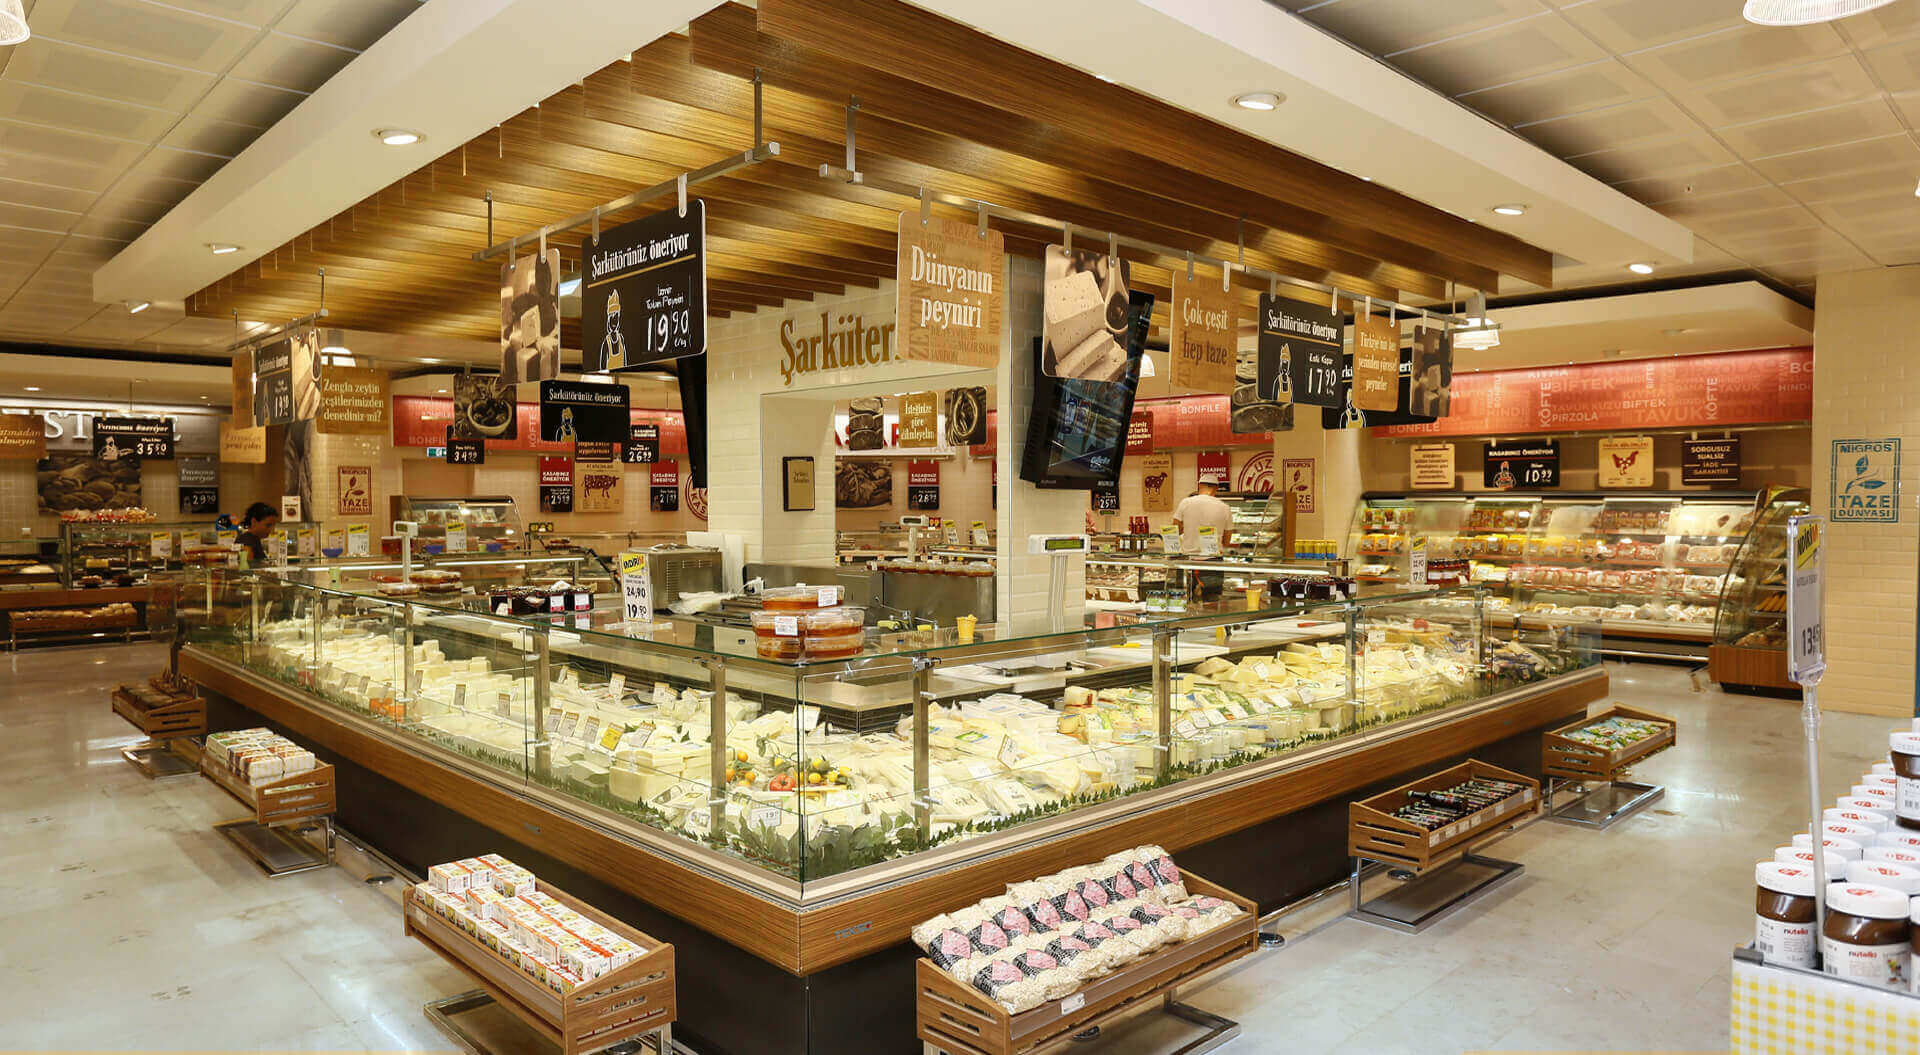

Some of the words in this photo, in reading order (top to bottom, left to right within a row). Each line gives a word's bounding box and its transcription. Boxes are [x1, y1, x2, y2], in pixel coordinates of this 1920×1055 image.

[591, 245, 648, 280] Şarkütörünüz
[650, 232, 690, 260] öneriyor
[911, 244, 993, 294] Dünyanın
[920, 297, 982, 330] peyniri
[1183, 298, 1203, 326] Çok
[1206, 309, 1228, 333] çeşit
[1268, 309, 1312, 334] Şarkütörünüz
[1312, 320, 1338, 341] öneriyor
[781, 312, 900, 386] Şarküter
[1184, 331, 1203, 366] hep
[1206, 340, 1228, 364] taze
[323, 378, 353, 394] Zengin
[354, 383, 381, 396] zeytin
[594, 395, 624, 404] öneriyor
[323, 408, 364, 421] denediniz
[367, 410, 382, 423] mi?
[1838, 495, 1891, 508] TAZE
